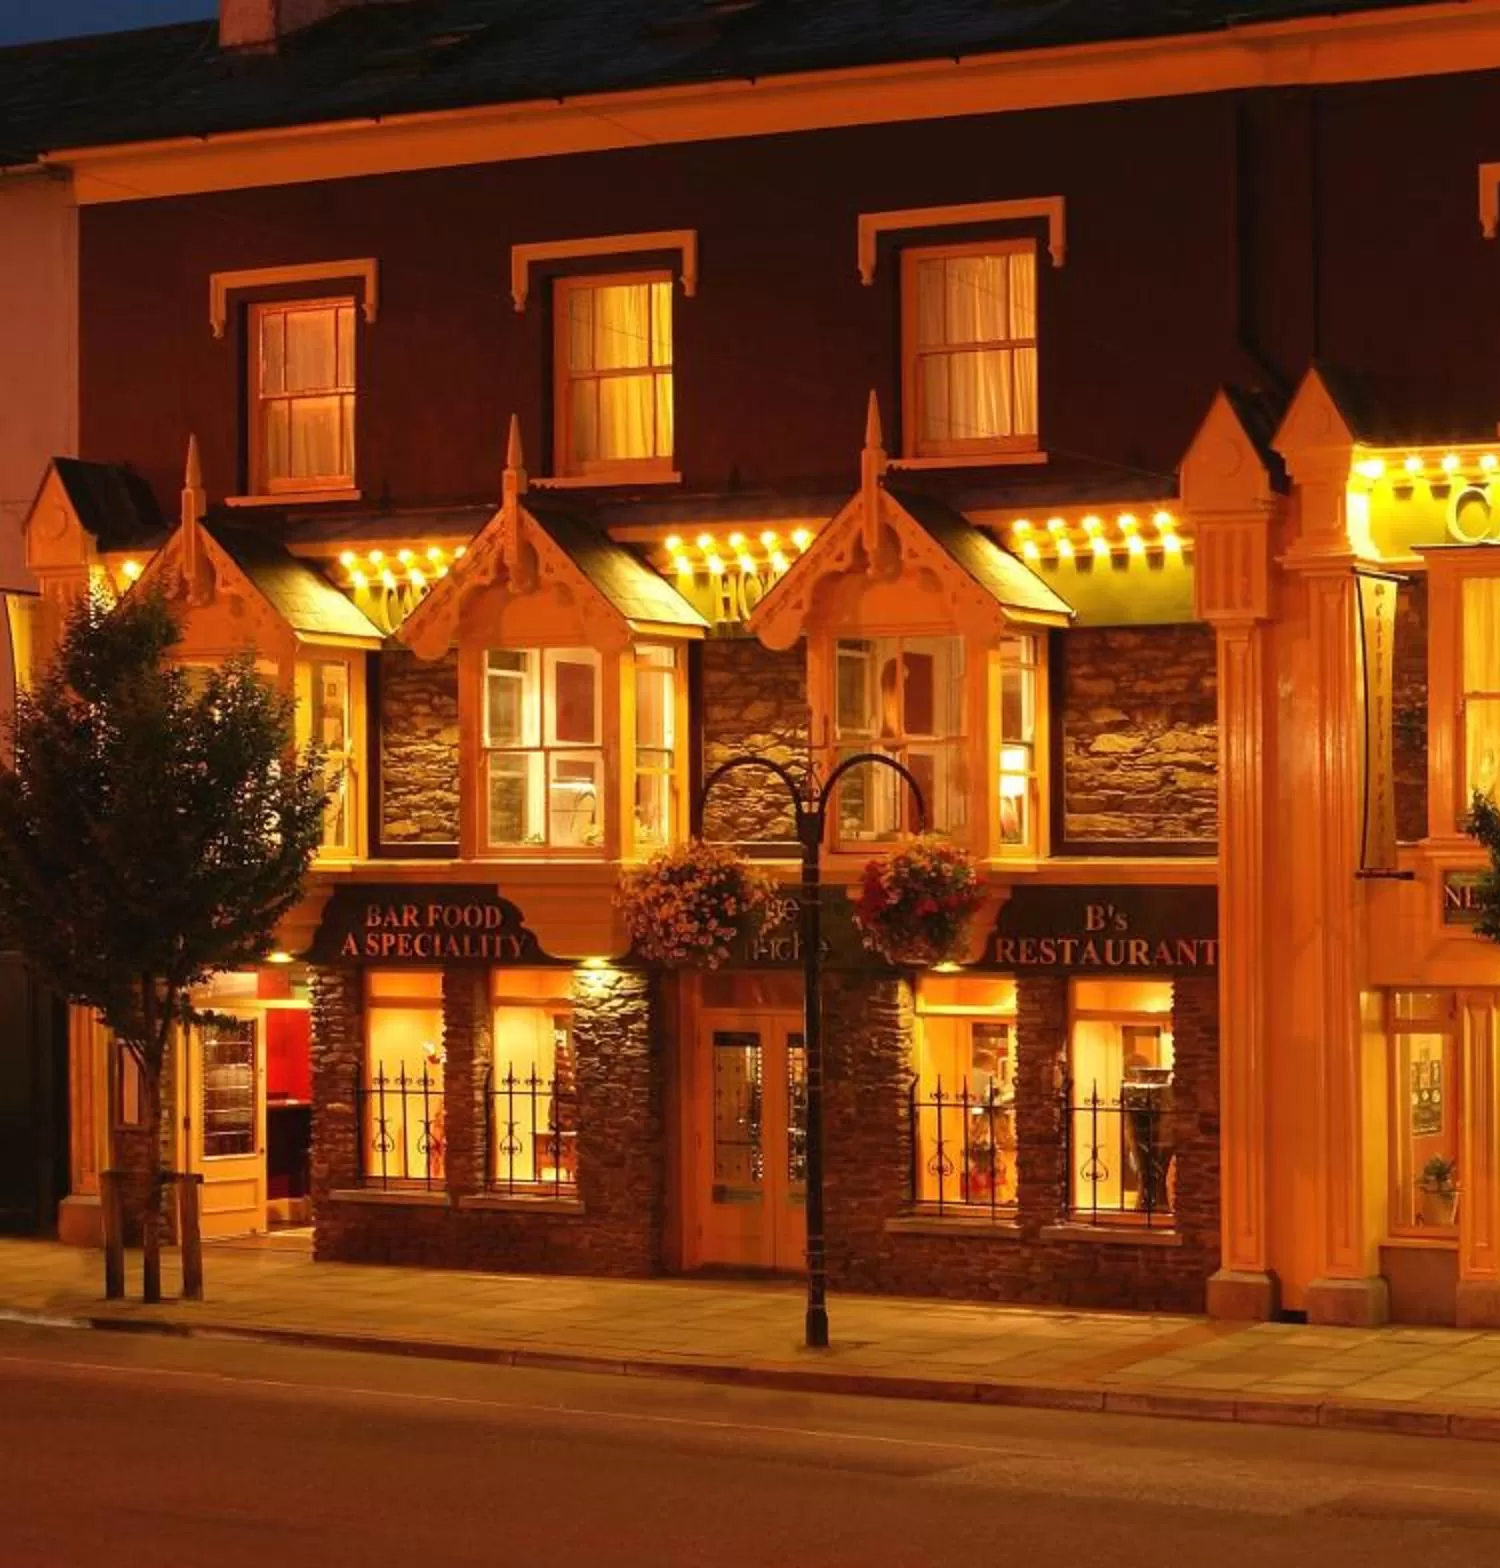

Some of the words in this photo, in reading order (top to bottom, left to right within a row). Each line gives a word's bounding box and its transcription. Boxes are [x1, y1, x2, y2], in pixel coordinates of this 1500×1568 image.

[366, 904, 420, 928] BAR
[427, 904, 503, 929] FOOD
[1086, 903, 1128, 931] B's
[341, 933, 359, 956] A
[365, 933, 525, 958] SPECIALITY
[995, 937, 1218, 966] RESTAURANT
